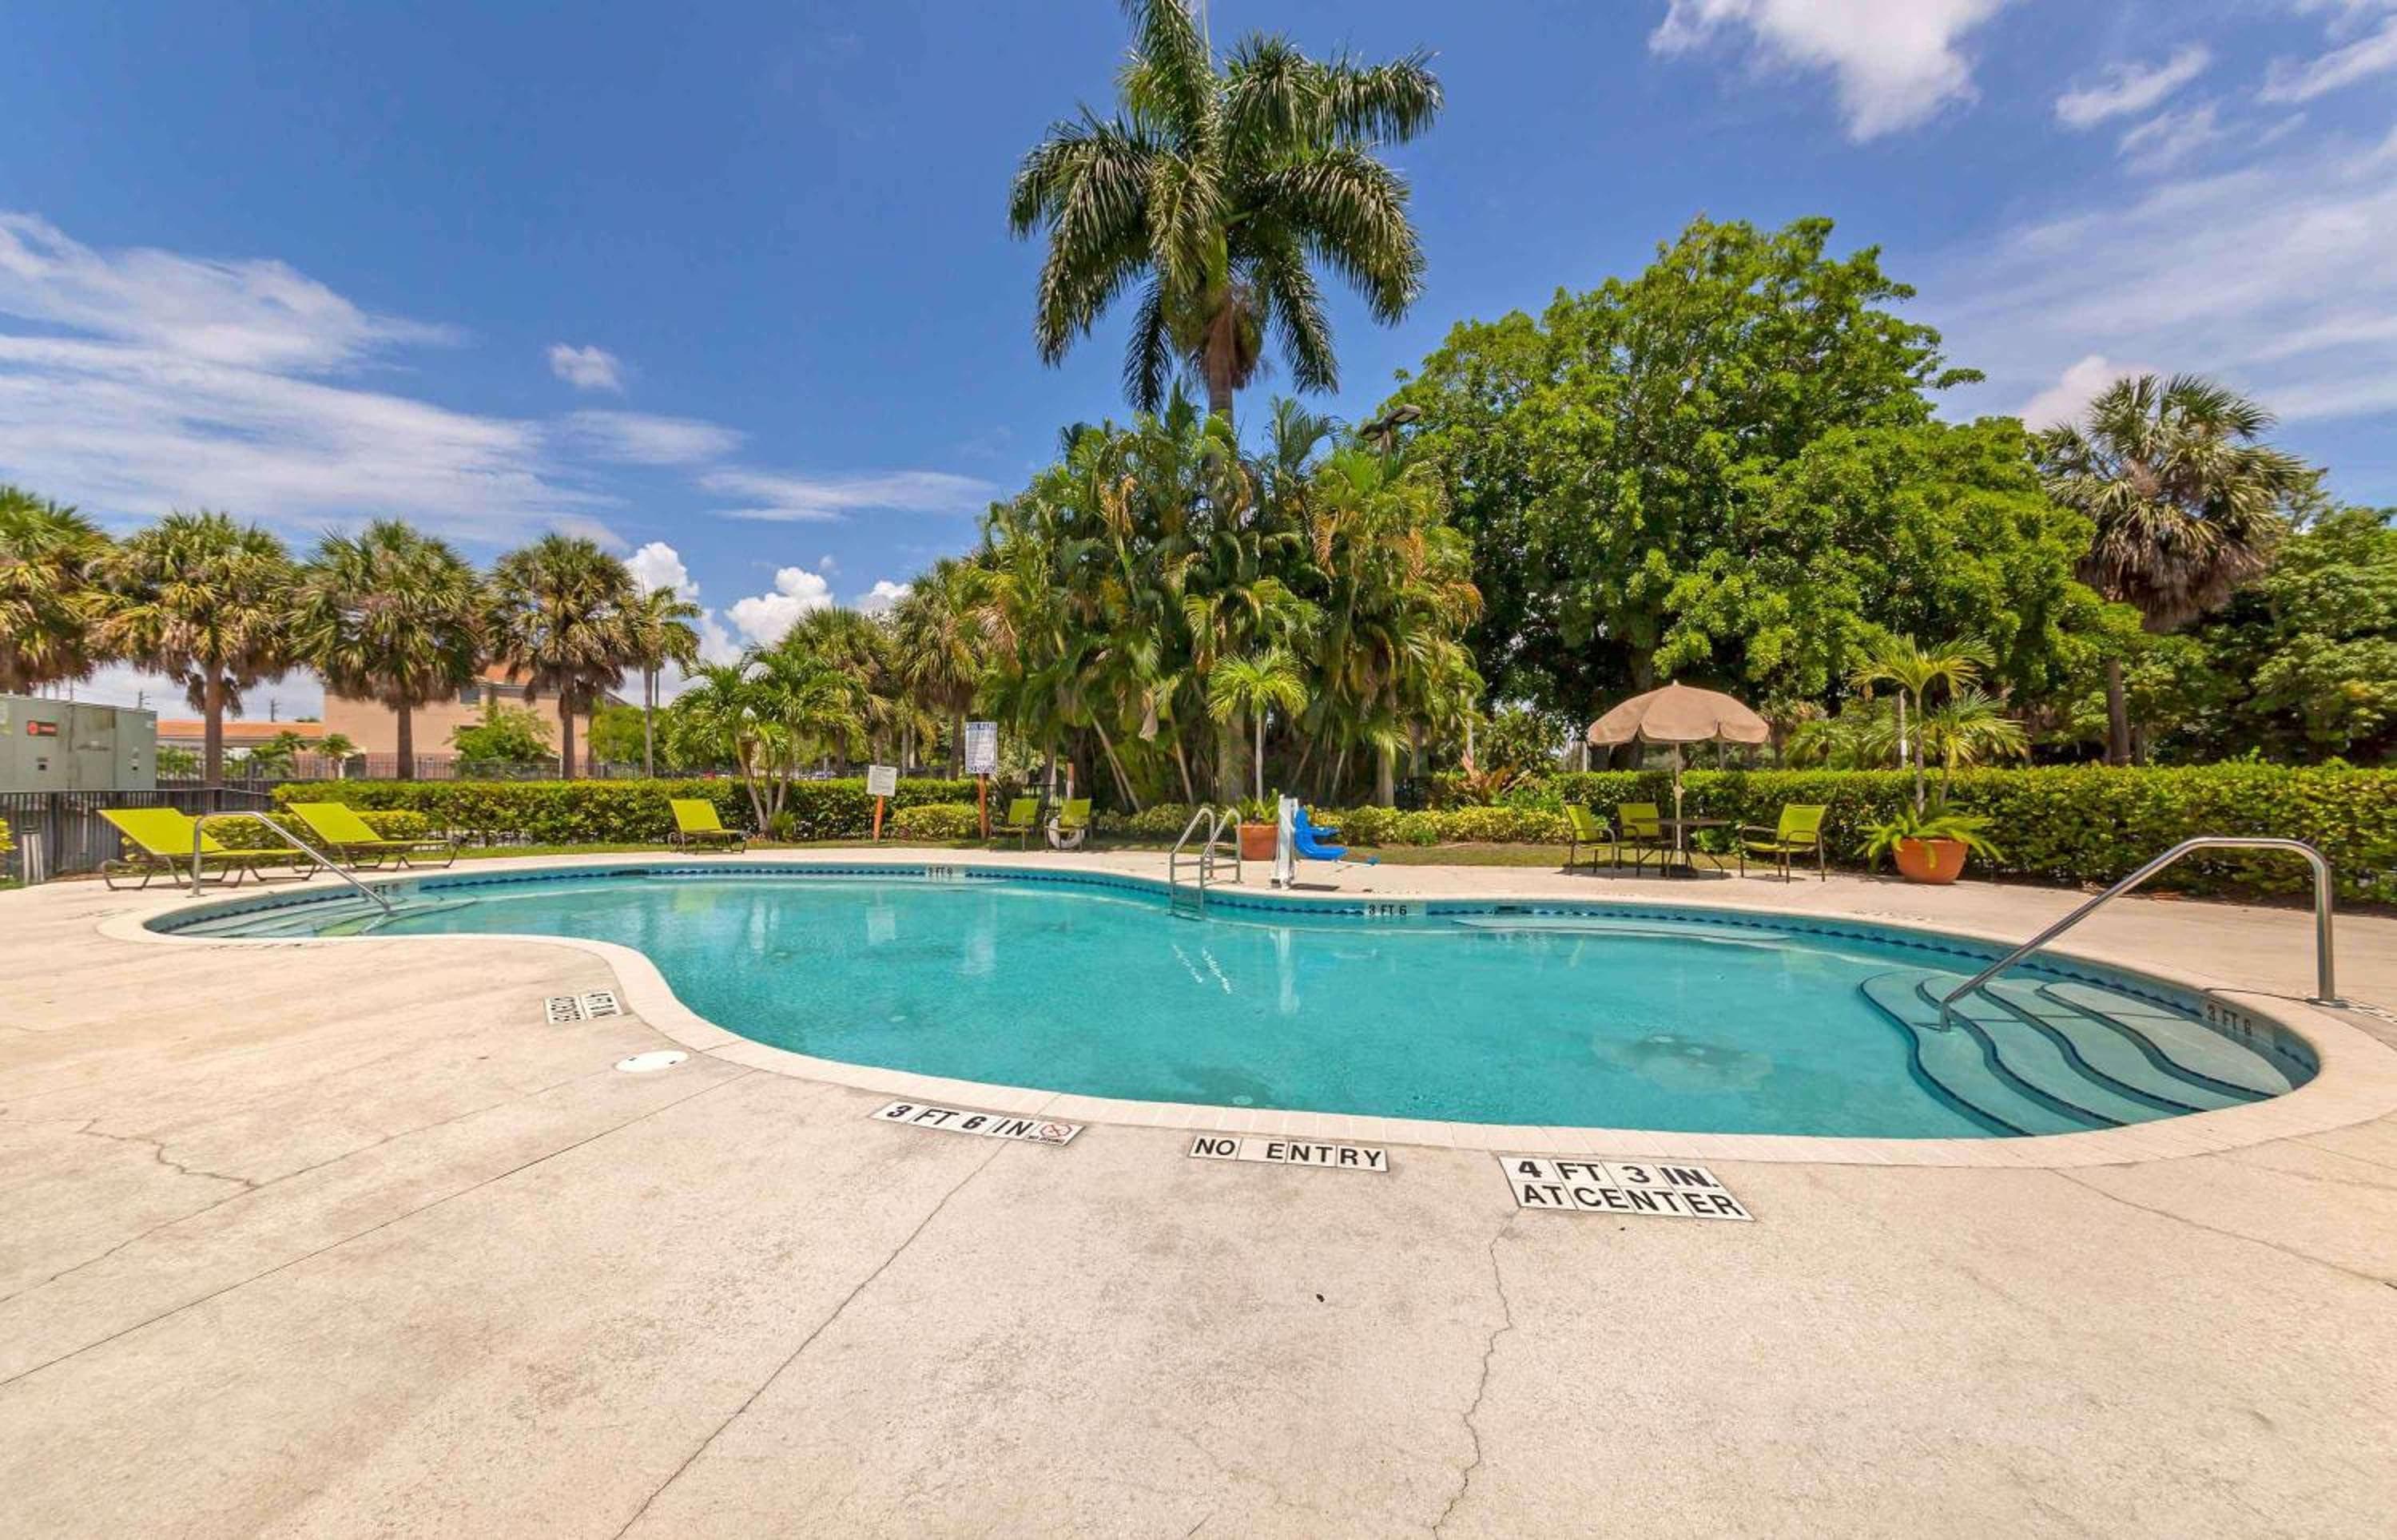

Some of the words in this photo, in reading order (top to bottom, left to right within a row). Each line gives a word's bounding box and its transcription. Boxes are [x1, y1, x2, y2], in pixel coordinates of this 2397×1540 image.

[1369, 904, 1375, 915] 3
[1381, 904, 1393, 915] FT
[1399, 905, 1407, 915] 6
[2224, 1010, 2238, 1030] FT
[886, 1105, 912, 1117] 3
[913, 1109, 959, 1125] FT
[961, 1116, 988, 1129] 6
[992, 1119, 1033, 1136] IN
[1195, 1138, 1235, 1156] NO
[1266, 1143, 1381, 1167] ENTRY
[1518, 1161, 1542, 1178] 4
[1556, 1162, 1601, 1181] FT
[1622, 1165, 1650, 1184] 3
[1660, 1167, 1720, 1189] IN.
[1524, 1185, 1564, 1205] AT
[1573, 1187, 1744, 1217] CENTER
